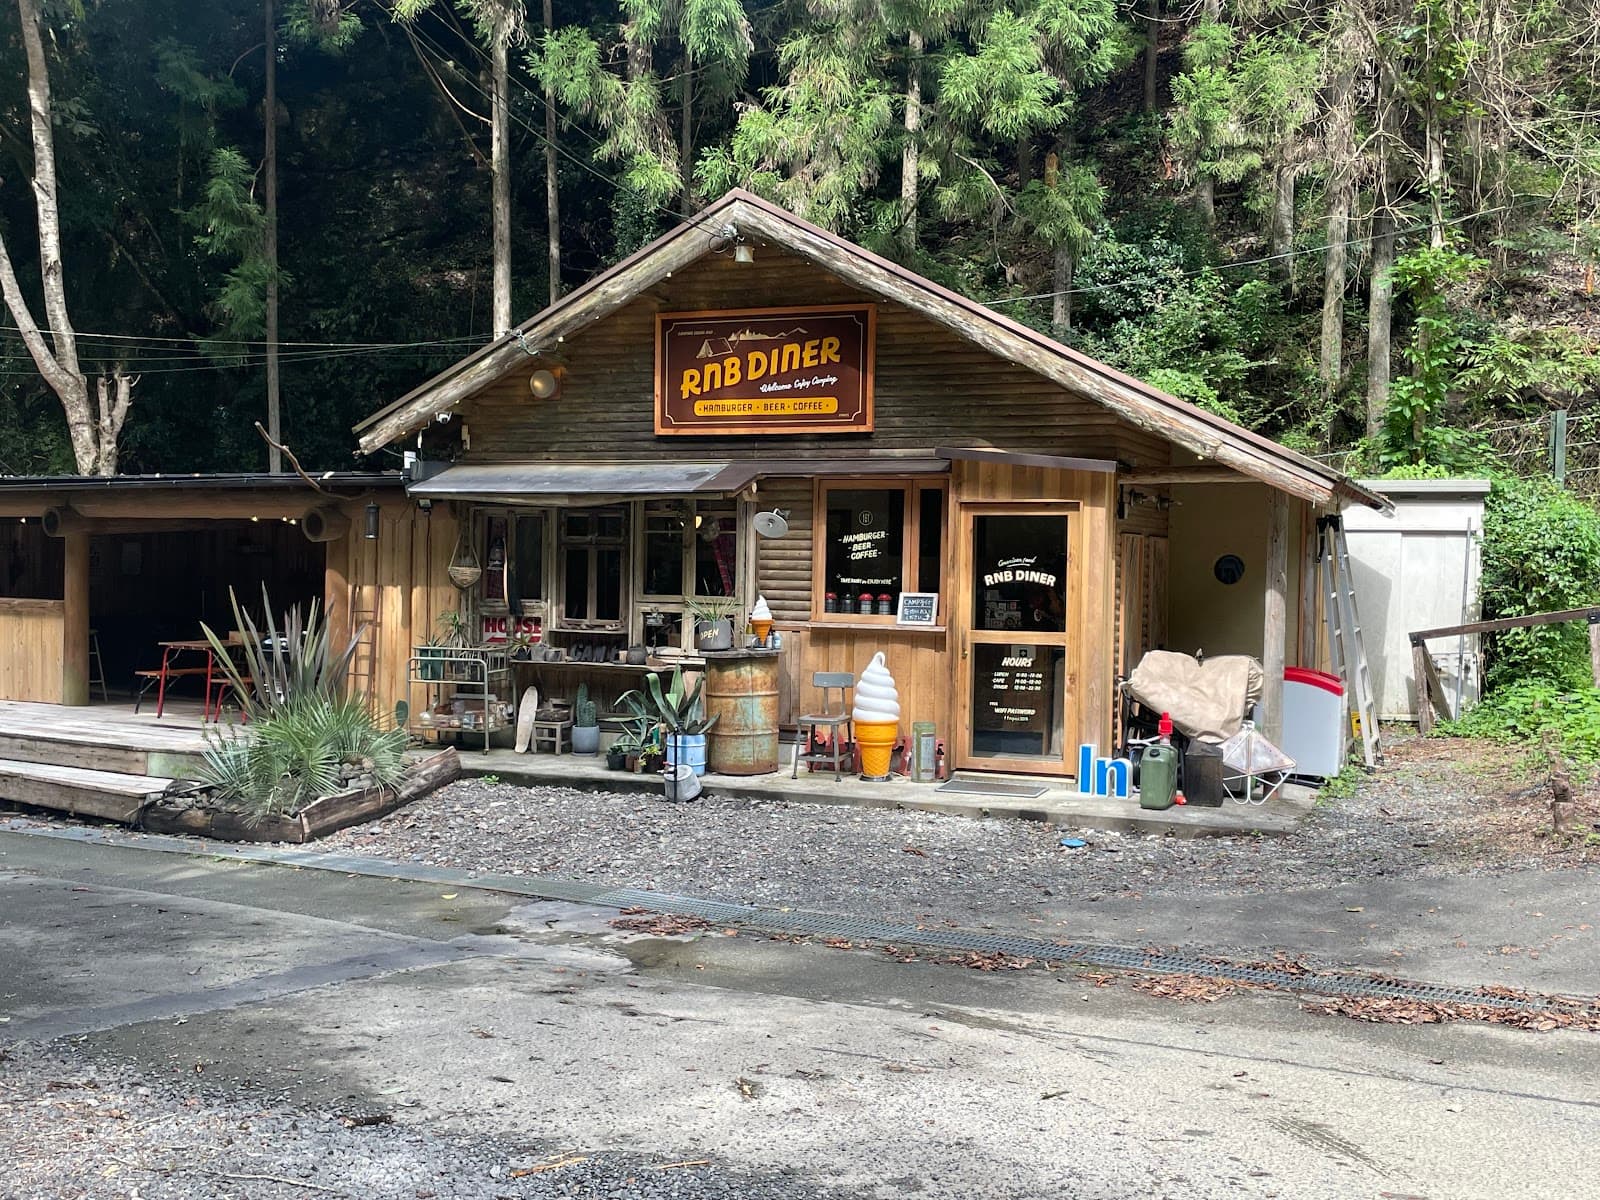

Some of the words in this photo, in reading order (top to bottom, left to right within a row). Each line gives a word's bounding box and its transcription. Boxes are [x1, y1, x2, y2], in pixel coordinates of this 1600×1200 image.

[680, 357, 742, 399] RNB
[747, 336, 841, 381] DINER
[759, 382, 793, 393] Welcome
[794, 379, 811, 390] Enjoy
[811, 374, 839, 388] Camping
[703, 401, 753, 413] HAMBURGER
[763, 401, 786, 411] BEER
[793, 401, 823, 411] COFFEE
[984, 570, 1014, 587] RNB
[1015, 569, 1056, 587] DINER
[700, 628, 720, 642] OPEN
[1001, 657, 1033, 667] HOURS
